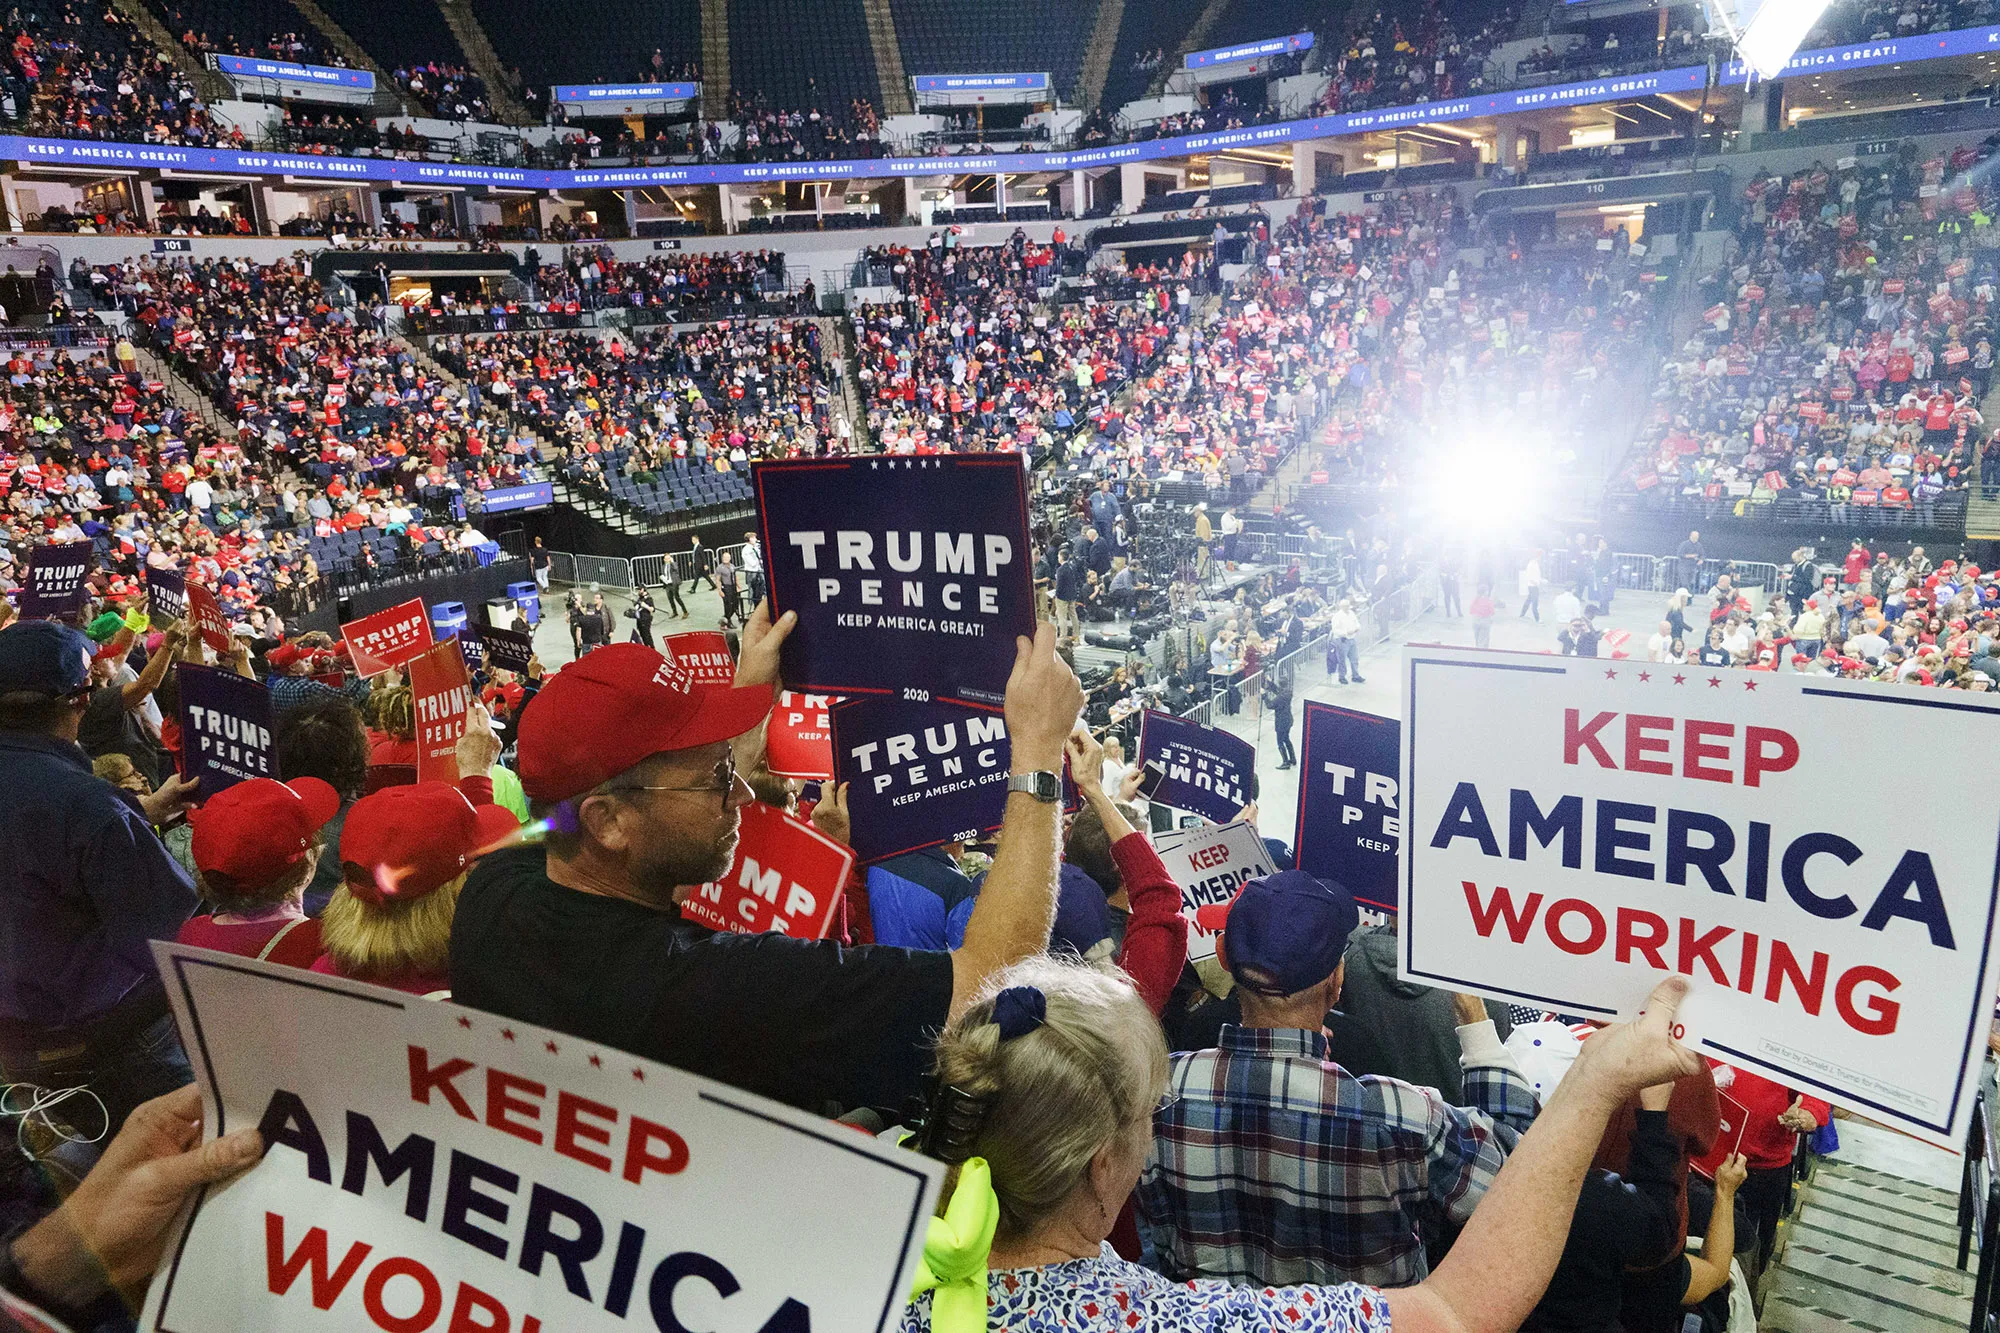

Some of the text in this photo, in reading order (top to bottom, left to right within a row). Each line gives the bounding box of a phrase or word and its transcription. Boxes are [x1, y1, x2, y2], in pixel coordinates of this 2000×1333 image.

[1785, 54, 1835, 68] ERICA
[1842, 45, 1897, 60] GREAT!
[257, 64, 339, 81] KEEP AMERICA GREAT!
[1516, 79, 1657, 105] KEEP AMERICA GREAT!
[1347, 104, 1469, 127] KEEP AMERICA GREAT!
[1186, 128, 1291, 148] KEEP AMERICA GREAT!
[1867, 143, 1886, 154] 111
[28, 144, 187, 162] KEEP AMERICA GREAT!
[1045, 148, 1139, 165] KEEP AMERICA GREAT!
[238, 157, 367, 173] KEEP AMERICA GREAT!
[419, 167, 524, 181] KEEP AMERICA GREAT!
[575, 171, 688, 182] KEEP AMERICA GREAT!
[744, 165, 853, 176] KEEP AMERICA GREAT!
[891, 160, 997, 171] KEEP AMERICA GREAT!
[1587, 184, 1604, 193] 110
[164, 241, 181, 250] 101
[660, 241, 675, 249] 104
[487, 495, 513, 505] AMERICA
[789, 530, 1012, 577] TRUMP
[34, 564, 85, 580] TRUMP
[36, 580, 78, 591] PENCE
[818, 578, 999, 614] PENCE
[353, 615, 422, 648] TRUMP
[837, 613, 985, 637] KEEP AMERICA GREAT!
[365, 629, 420, 655] PENCE
[461, 641, 483, 650] TRU
[678, 653, 731, 667] TRUMP
[652, 657, 677, 687] TRU
[688, 668, 731, 677] PENCE
[418, 684, 471, 723] TRUMP
[903, 688, 929, 702] 2020
[189, 705, 271, 752] TRUMP
[426, 720, 462, 744] PENC
[798, 732, 822, 741] KEEP
[201, 736, 268, 773] PENCE
[851, 716, 1006, 773] TRUM
[1563, 708, 1800, 788] KEEP
[873, 748, 997, 794] PENC
[1160, 747, 1240, 785] PENCE
[892, 769, 1010, 807] KEEP AMERICA GREA
[953, 829, 978, 842] 2020
[1357, 837, 1391, 853] KEEP
[1188, 843, 1230, 873] KEEP
[1429, 781, 1958, 952] AMERICA
[681, 899, 726, 927] MERICA
[700, 882, 790, 934] NCE
[1460, 880, 1903, 1037] WORKING
[406, 1044, 690, 1186] KEEP
